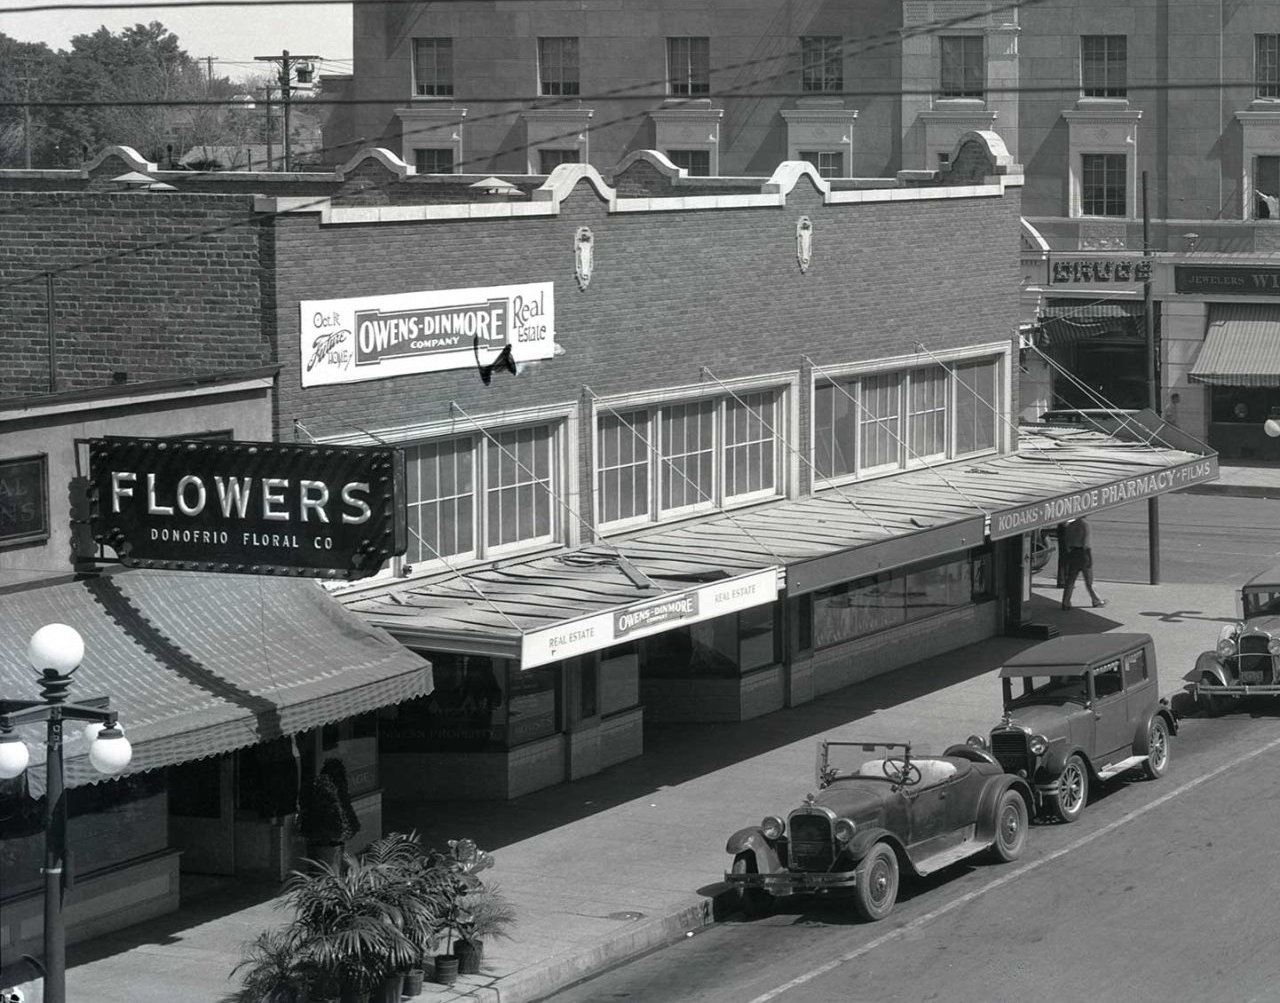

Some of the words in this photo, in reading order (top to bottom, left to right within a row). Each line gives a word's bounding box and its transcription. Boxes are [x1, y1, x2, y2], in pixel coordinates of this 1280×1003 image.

[1053, 261, 1153, 283] DRUGS
[1188, 275, 1245, 286] JEWELERS
[513, 291, 545, 329] Real
[359, 309, 504, 354] OWENS-DINMORE
[410, 336, 460, 349] COMPANY
[111, 471, 372, 525] FLOWERS
[999, 506, 1039, 531] KODAKS
[1044, 490, 1099, 520] MONROE
[1101, 469, 1176, 503] PHARMACY
[1181, 461, 1211, 481] FILMS
[151, 528, 228, 544] DONOFRIO
[243, 533, 299, 548] FLORAL
[314, 537, 333, 550] CO
[549, 633, 568, 648] REAL
[569, 627, 595, 643] ESTATE
[619, 598, 694, 631] OWENS-DINMORE
[715, 590, 731, 603] REAL
[731, 585, 756, 598] ESTATE
